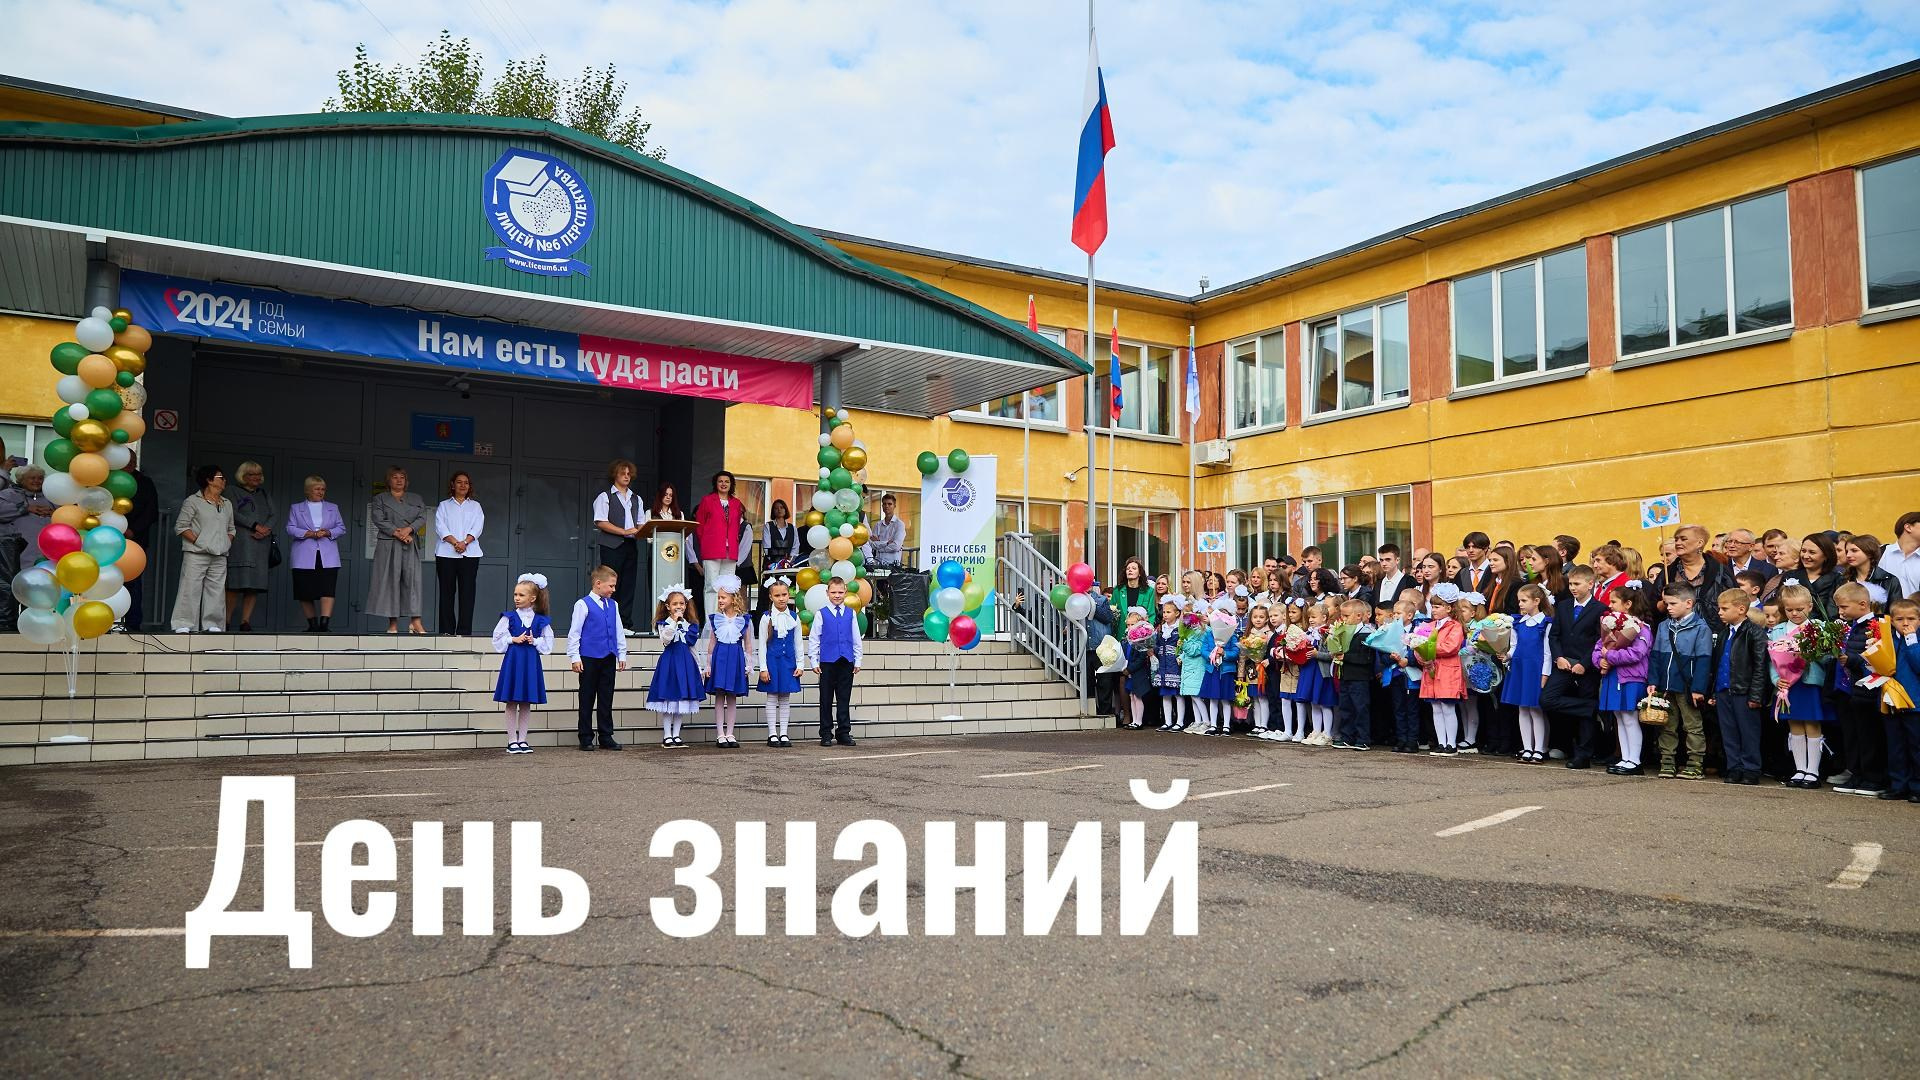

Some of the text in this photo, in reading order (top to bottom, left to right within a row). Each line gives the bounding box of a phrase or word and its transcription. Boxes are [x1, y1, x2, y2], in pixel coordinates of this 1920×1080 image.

[495, 166, 587, 251] ЛИЦЕЙ №6 ПЕРСПЕКТИВА
[509, 257, 568, 272] www.liceum6.ru
[177, 290, 252, 331] 2024
[258, 319, 305, 338] семьи
[418, 319, 739, 391] Нам есть куда расти
[930, 544, 986, 553] ВНЕСИ СЕБЯ
[931, 556, 937, 564] В
